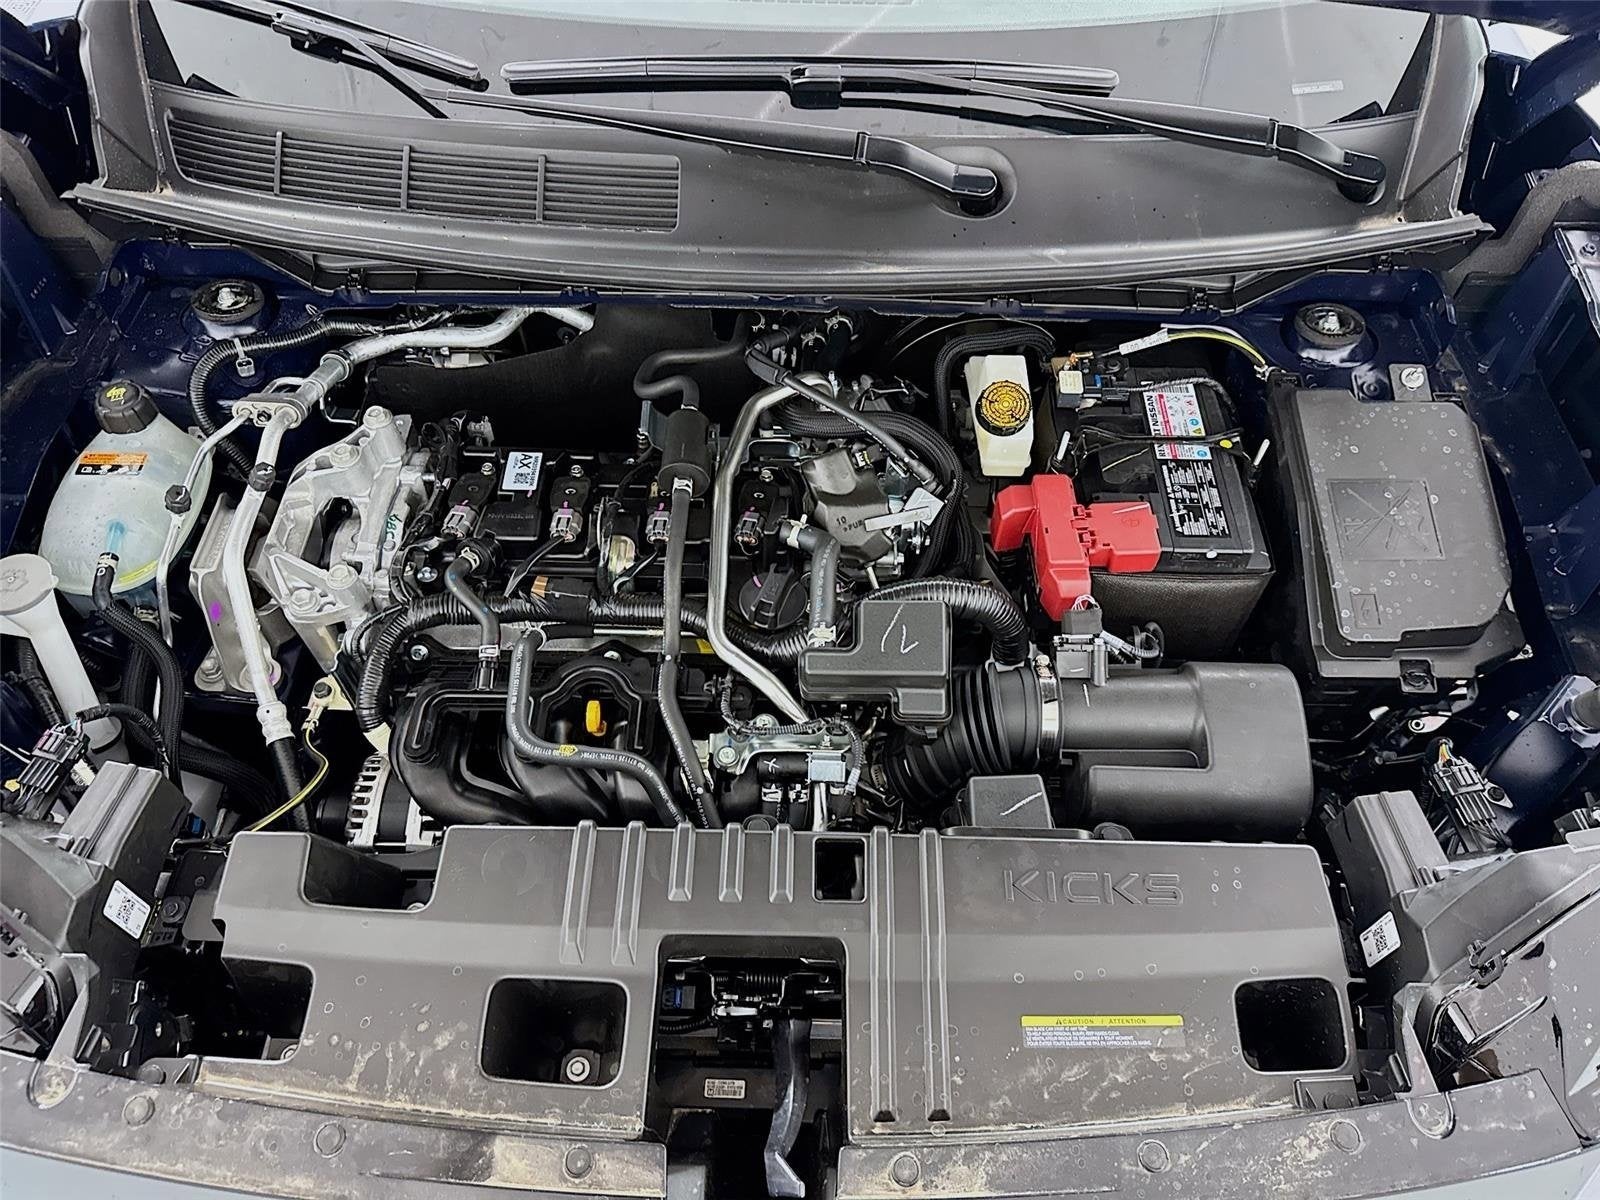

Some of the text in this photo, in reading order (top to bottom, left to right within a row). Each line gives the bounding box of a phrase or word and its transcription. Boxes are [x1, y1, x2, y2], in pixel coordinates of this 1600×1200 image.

[1146, 395, 1160, 427] NISSAN
[518, 453, 533, 469] AX
[1004, 870, 1184, 905] KICKS
